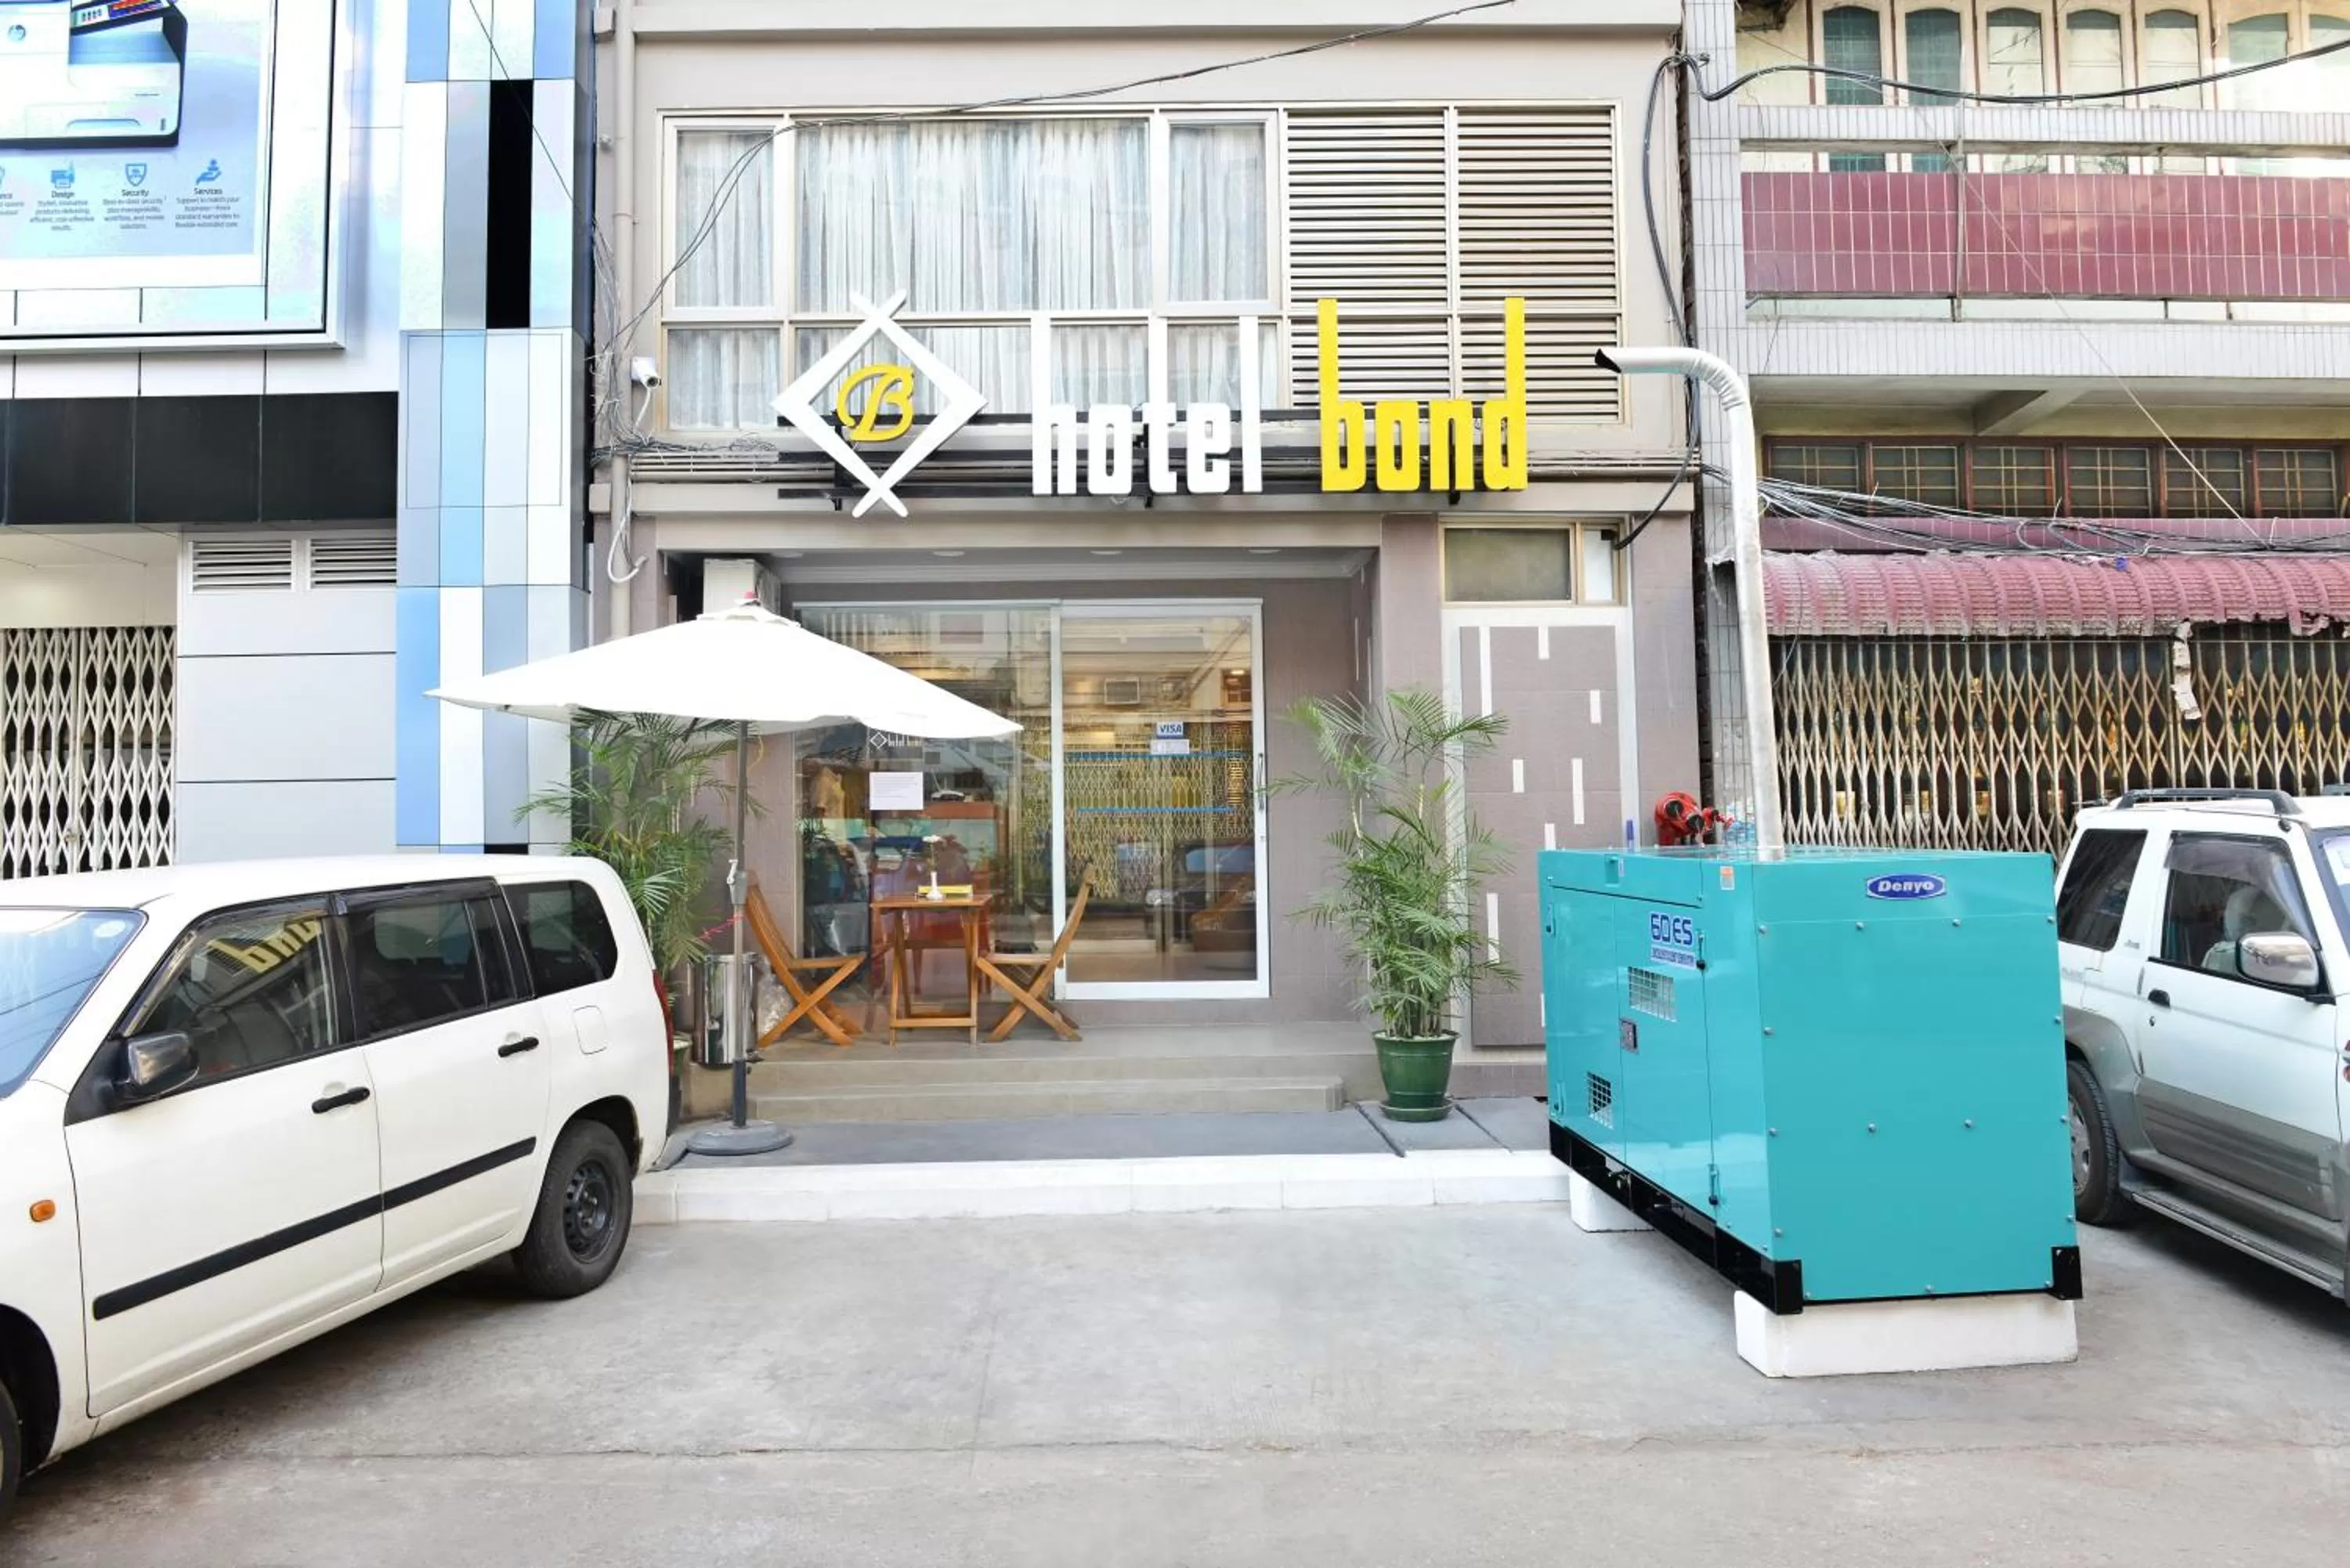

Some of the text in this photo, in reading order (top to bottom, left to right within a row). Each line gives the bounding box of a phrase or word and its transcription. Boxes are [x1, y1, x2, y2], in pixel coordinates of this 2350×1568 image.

[121, 189, 149, 197] Security
[1031, 296, 1528, 494] hotel bond
[1159, 724, 1182, 734] VISA
[1878, 880, 1935, 894] Denyo
